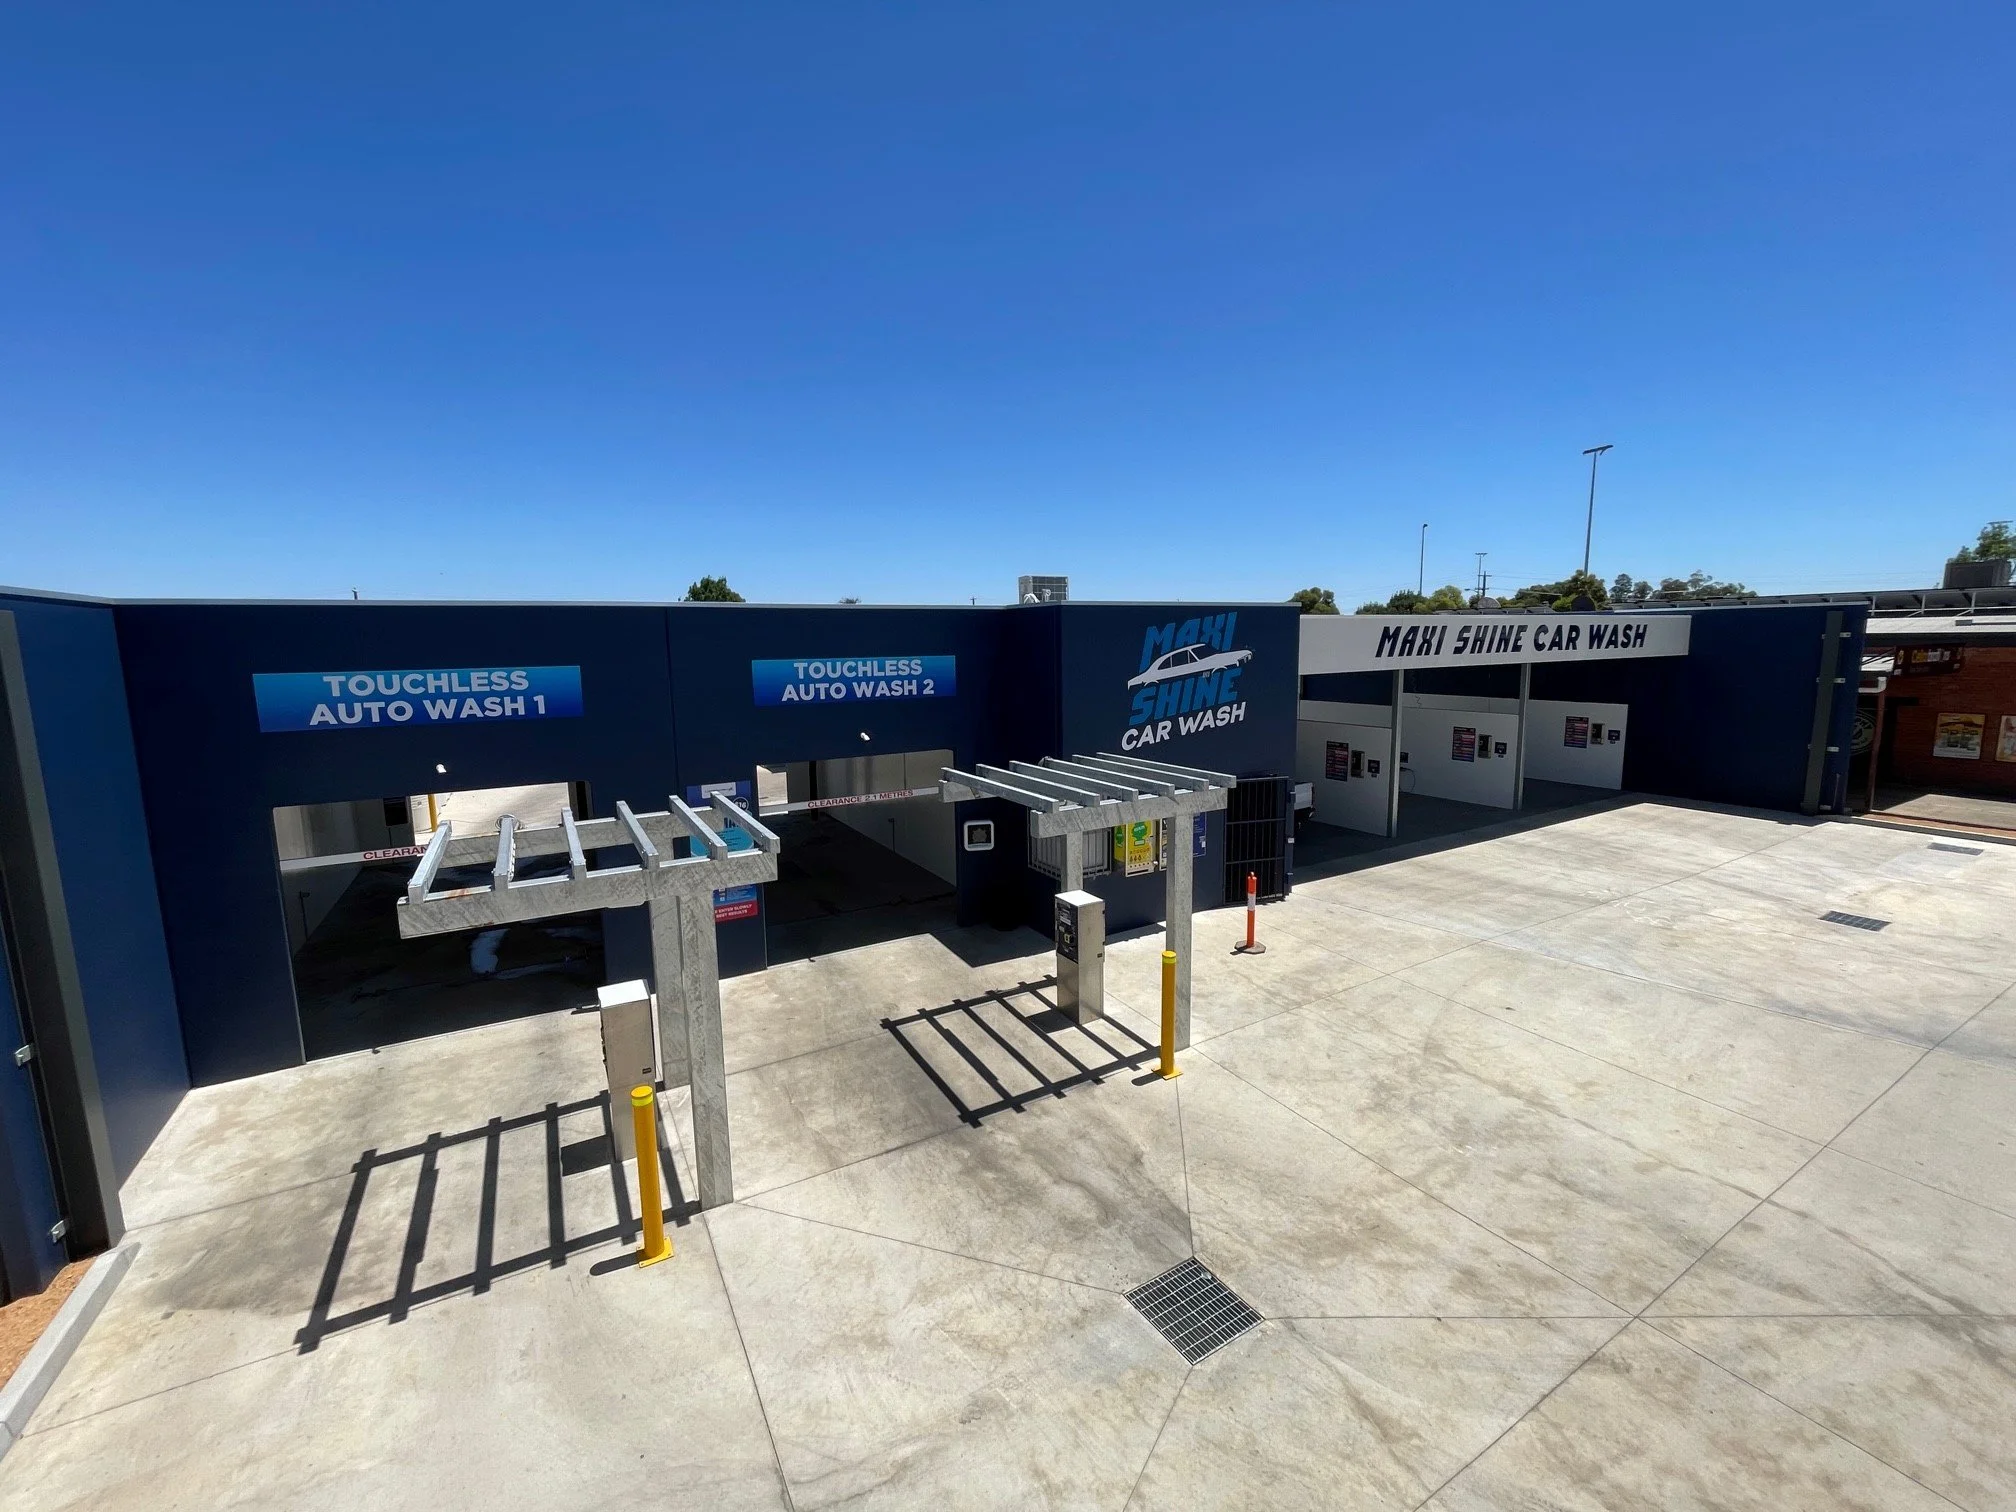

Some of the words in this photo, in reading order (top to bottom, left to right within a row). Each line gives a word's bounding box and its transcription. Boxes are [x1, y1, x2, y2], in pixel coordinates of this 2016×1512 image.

[1139, 612, 1237, 673] MAXI
[1375, 625, 1447, 658] MAXI
[1453, 624, 1528, 655] SHINE
[1533, 624, 1581, 652] CAR
[1588, 623, 1648, 650] WASH
[323, 670, 529, 697] TOUCHLESS
[793, 659, 923, 679] TOUCHLESS
[781, 682, 847, 702] AUTO
[852, 679, 918, 698] WASH
[922, 678, 935, 695] 2
[1128, 667, 1243, 726] SHINE
[309, 700, 413, 726] AUTO
[423, 695, 525, 720] WASH
[533, 694, 546, 714] 1
[1121, 719, 1172, 751] CAR
[1178, 701, 1247, 736] WASH
[807, 796, 862, 809] CLEARANCE
[864, 794, 877, 802] 2.1
[879, 789, 914, 799] METRES
[363, 845, 428, 860] CLEARAN
